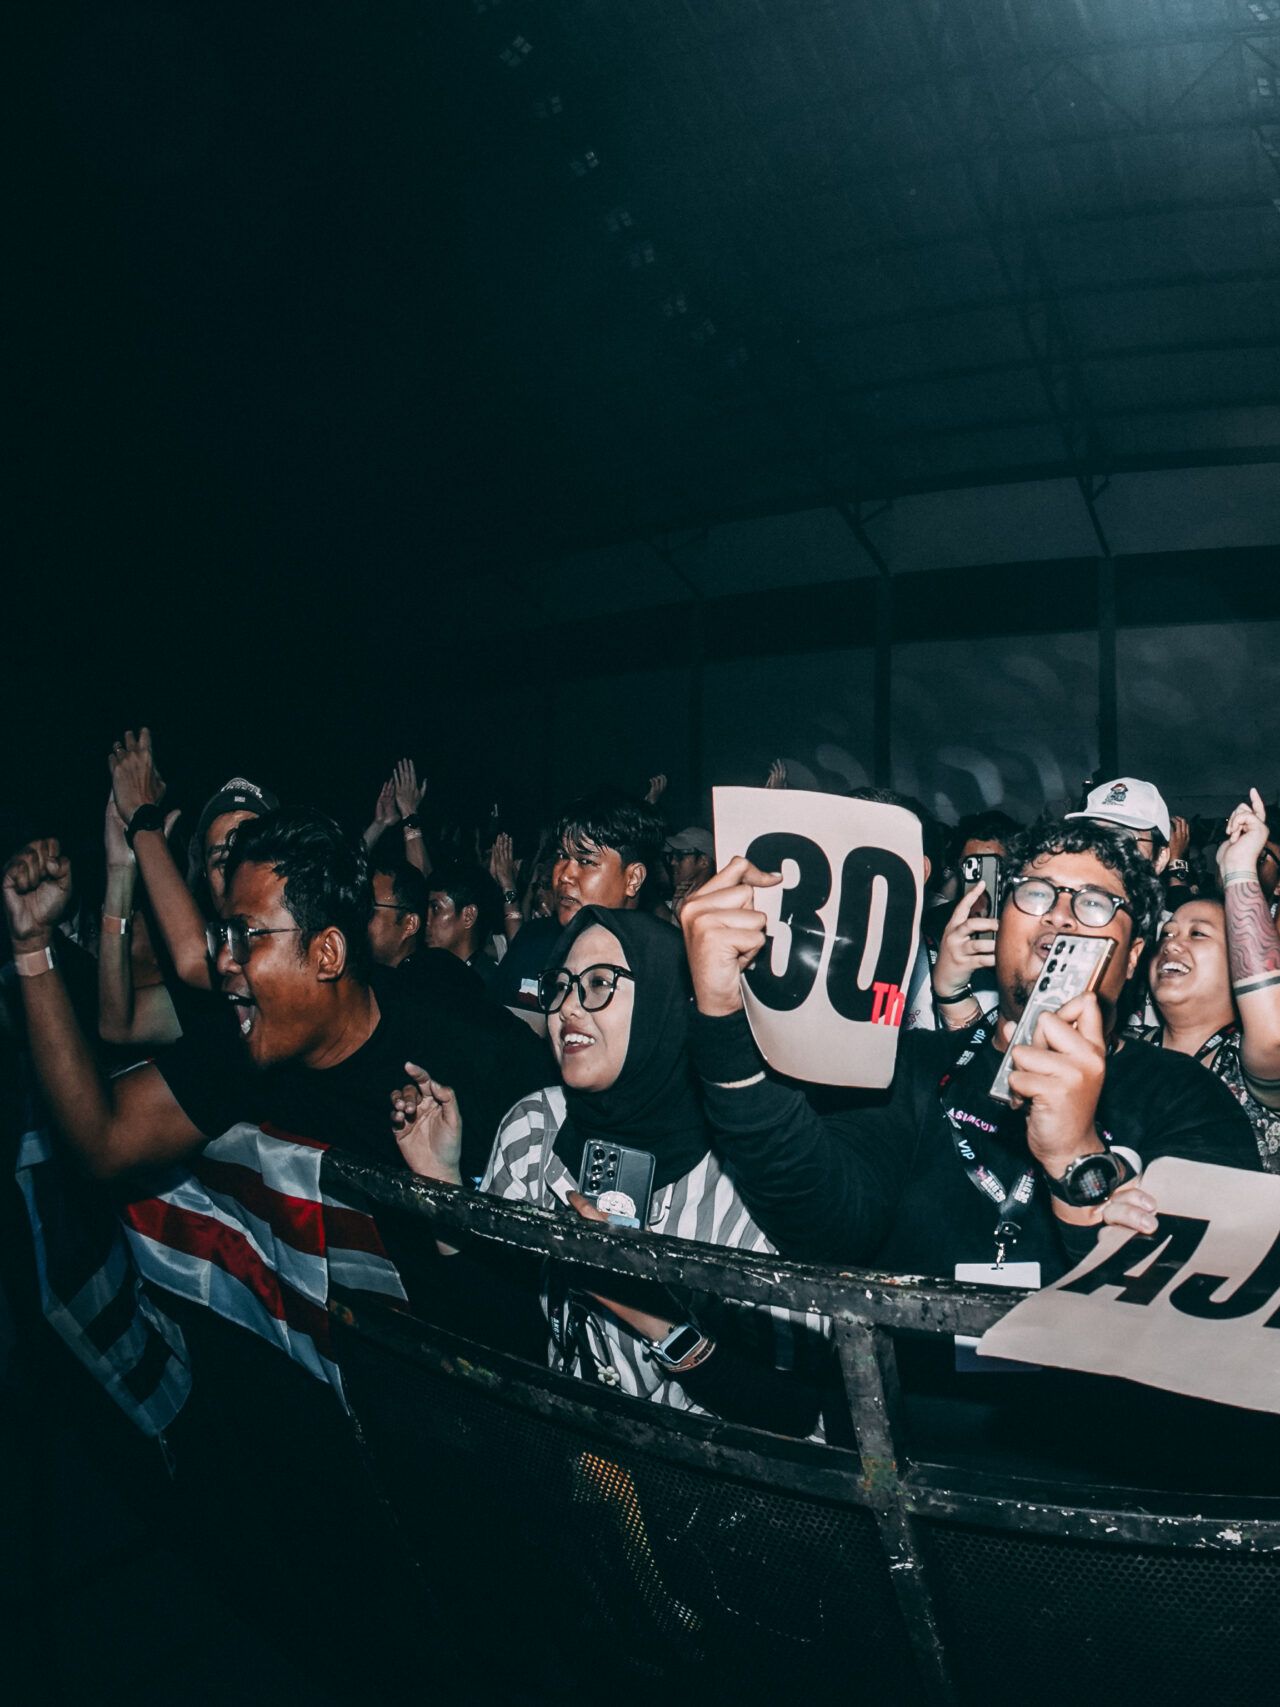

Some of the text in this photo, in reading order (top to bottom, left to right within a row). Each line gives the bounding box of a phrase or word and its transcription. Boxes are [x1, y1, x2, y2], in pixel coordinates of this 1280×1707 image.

[744, 832, 917, 1022] 30
[970, 1028, 987, 1045] VIP
[957, 1139, 976, 1160] VIP
